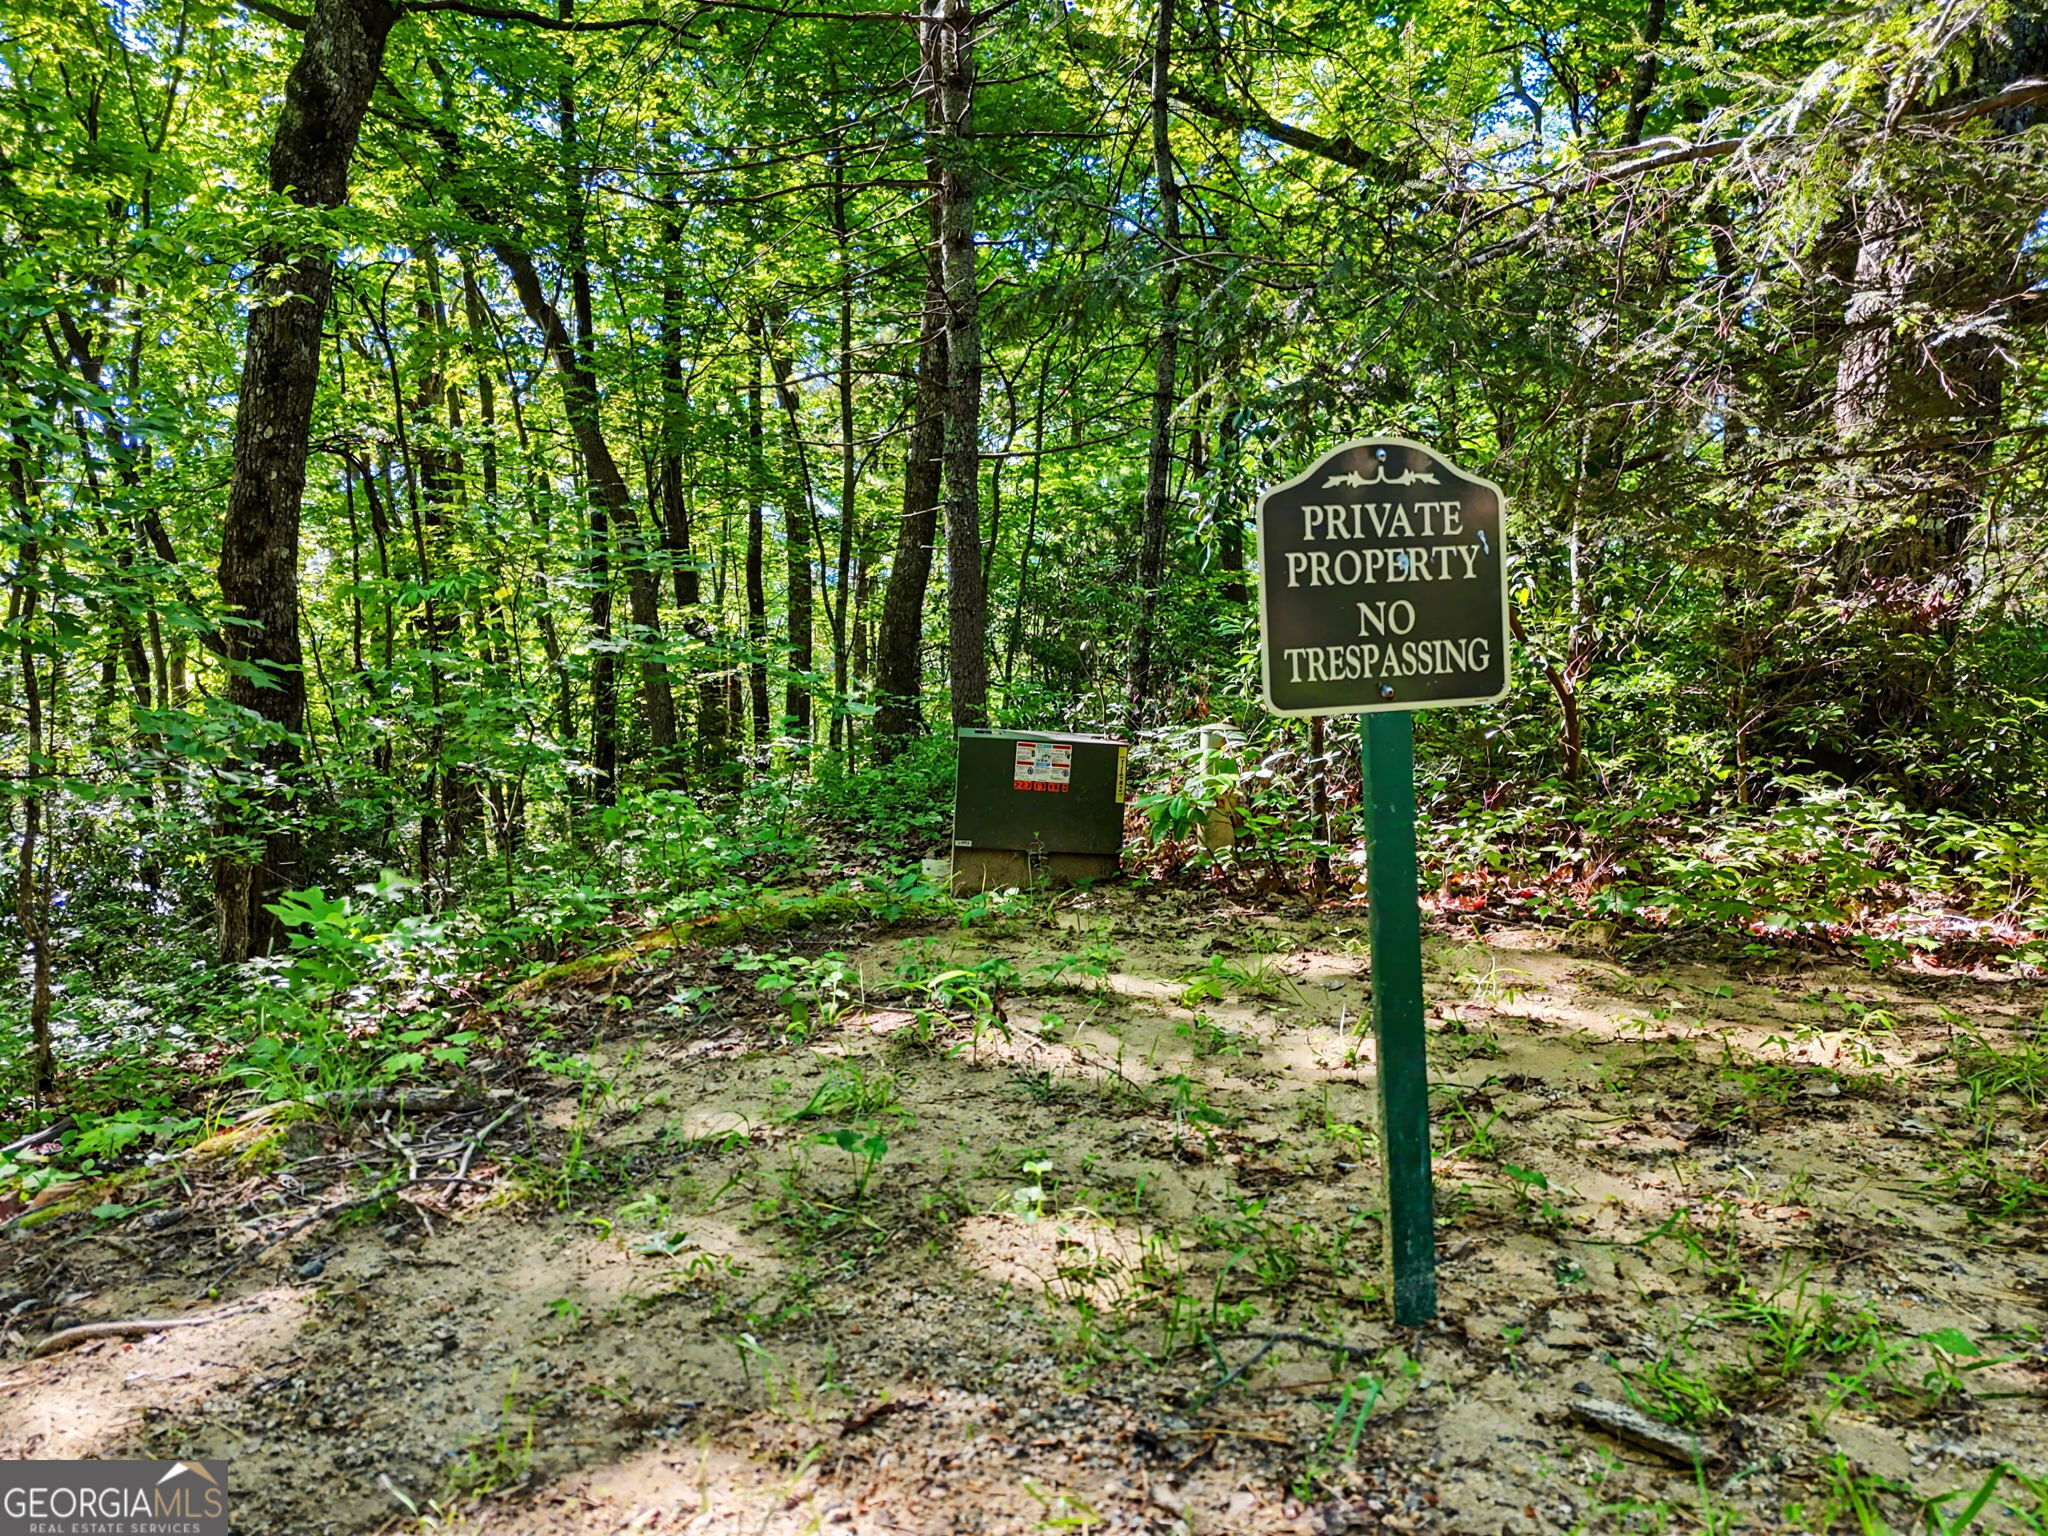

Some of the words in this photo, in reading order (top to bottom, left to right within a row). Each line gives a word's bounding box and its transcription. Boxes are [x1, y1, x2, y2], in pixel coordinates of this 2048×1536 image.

[1301, 501, 1464, 541] PRIVATE
[1285, 544, 1480, 588] PROPERTY
[1356, 600, 1416, 638] NO
[1283, 637, 1490, 683] TRESPASSING
